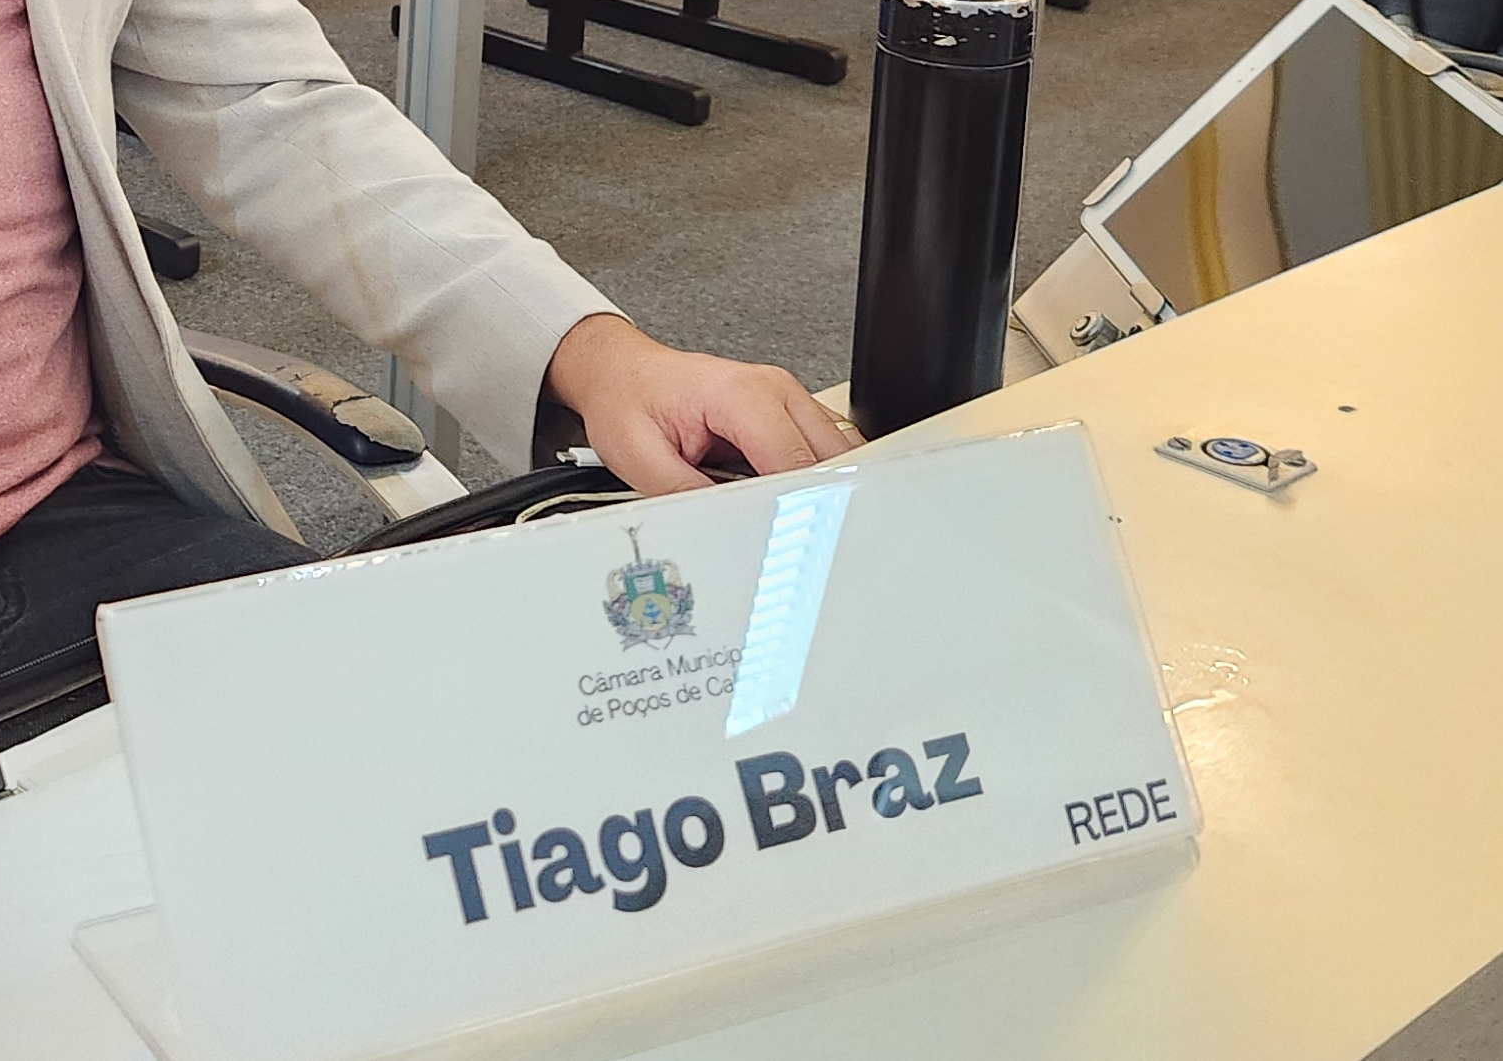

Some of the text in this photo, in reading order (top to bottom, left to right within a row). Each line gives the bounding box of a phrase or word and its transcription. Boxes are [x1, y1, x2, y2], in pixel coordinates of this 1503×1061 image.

[578, 646, 742, 696] Câmara Municip
[577, 704, 604, 726] de
[608, 694, 671, 718] Poços
[676, 684, 702, 704] de
[421, 732, 984, 925] Tiago Braz
[1064, 778, 1178, 846] REDE
